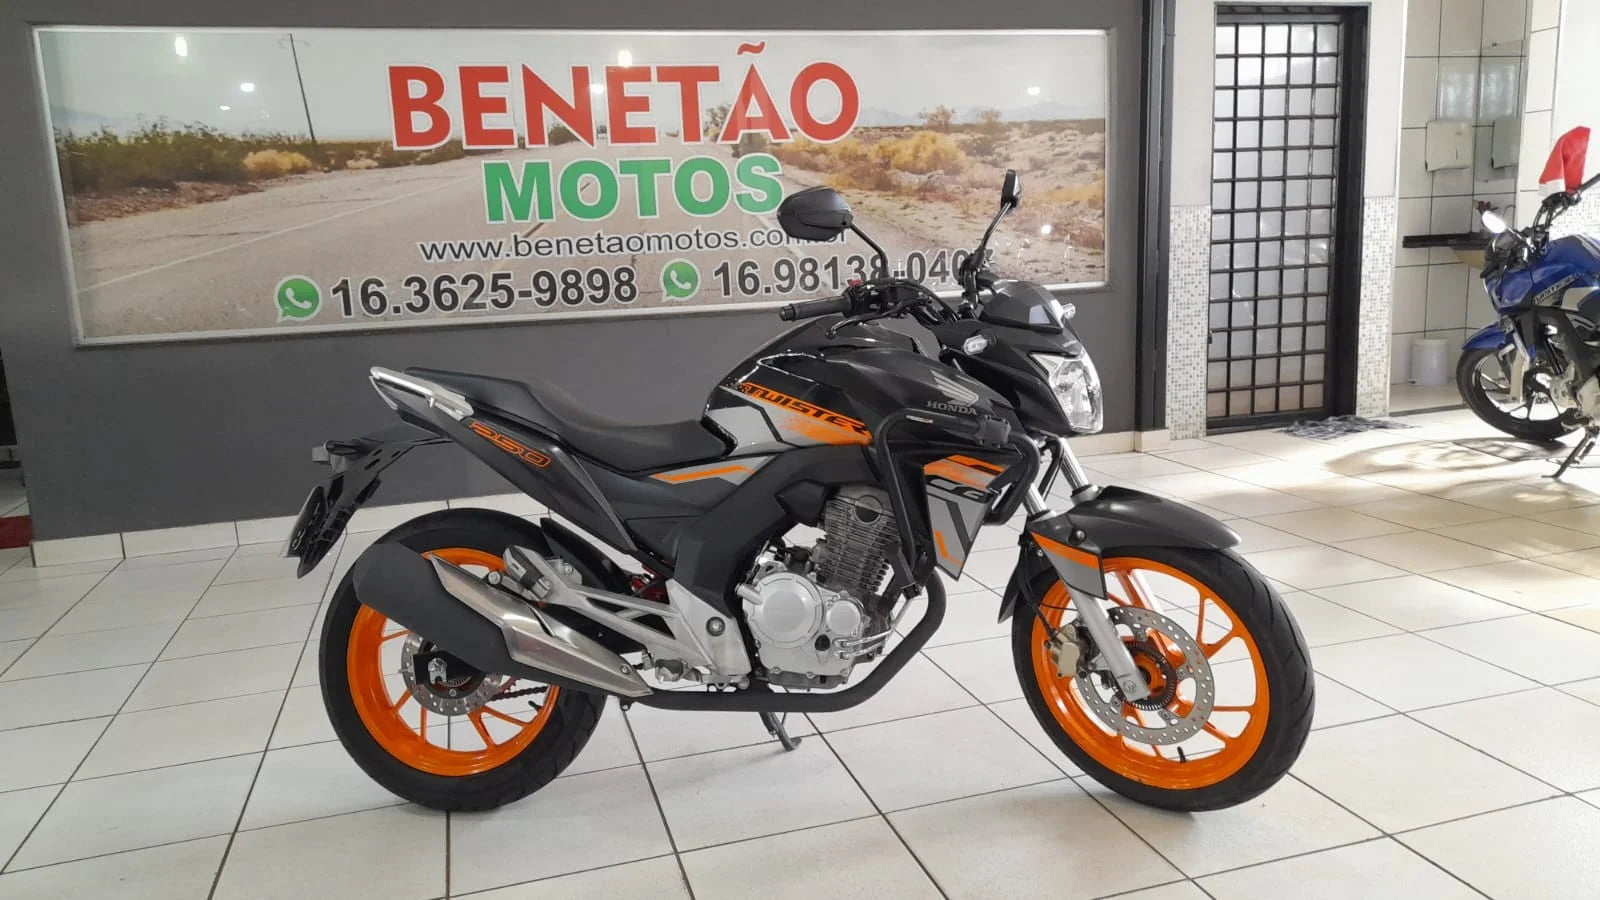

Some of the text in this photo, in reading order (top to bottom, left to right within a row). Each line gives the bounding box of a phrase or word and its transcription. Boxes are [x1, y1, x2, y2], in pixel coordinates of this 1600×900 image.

[388, 42, 860, 150] BENETÃO
[484, 156, 783, 224] MOTOS
[332, 266, 637, 317] 16.3625-9898
[744, 383, 869, 435] TWISTER
[926, 400, 978, 416] HONDA
[467, 420, 553, 469] 250
